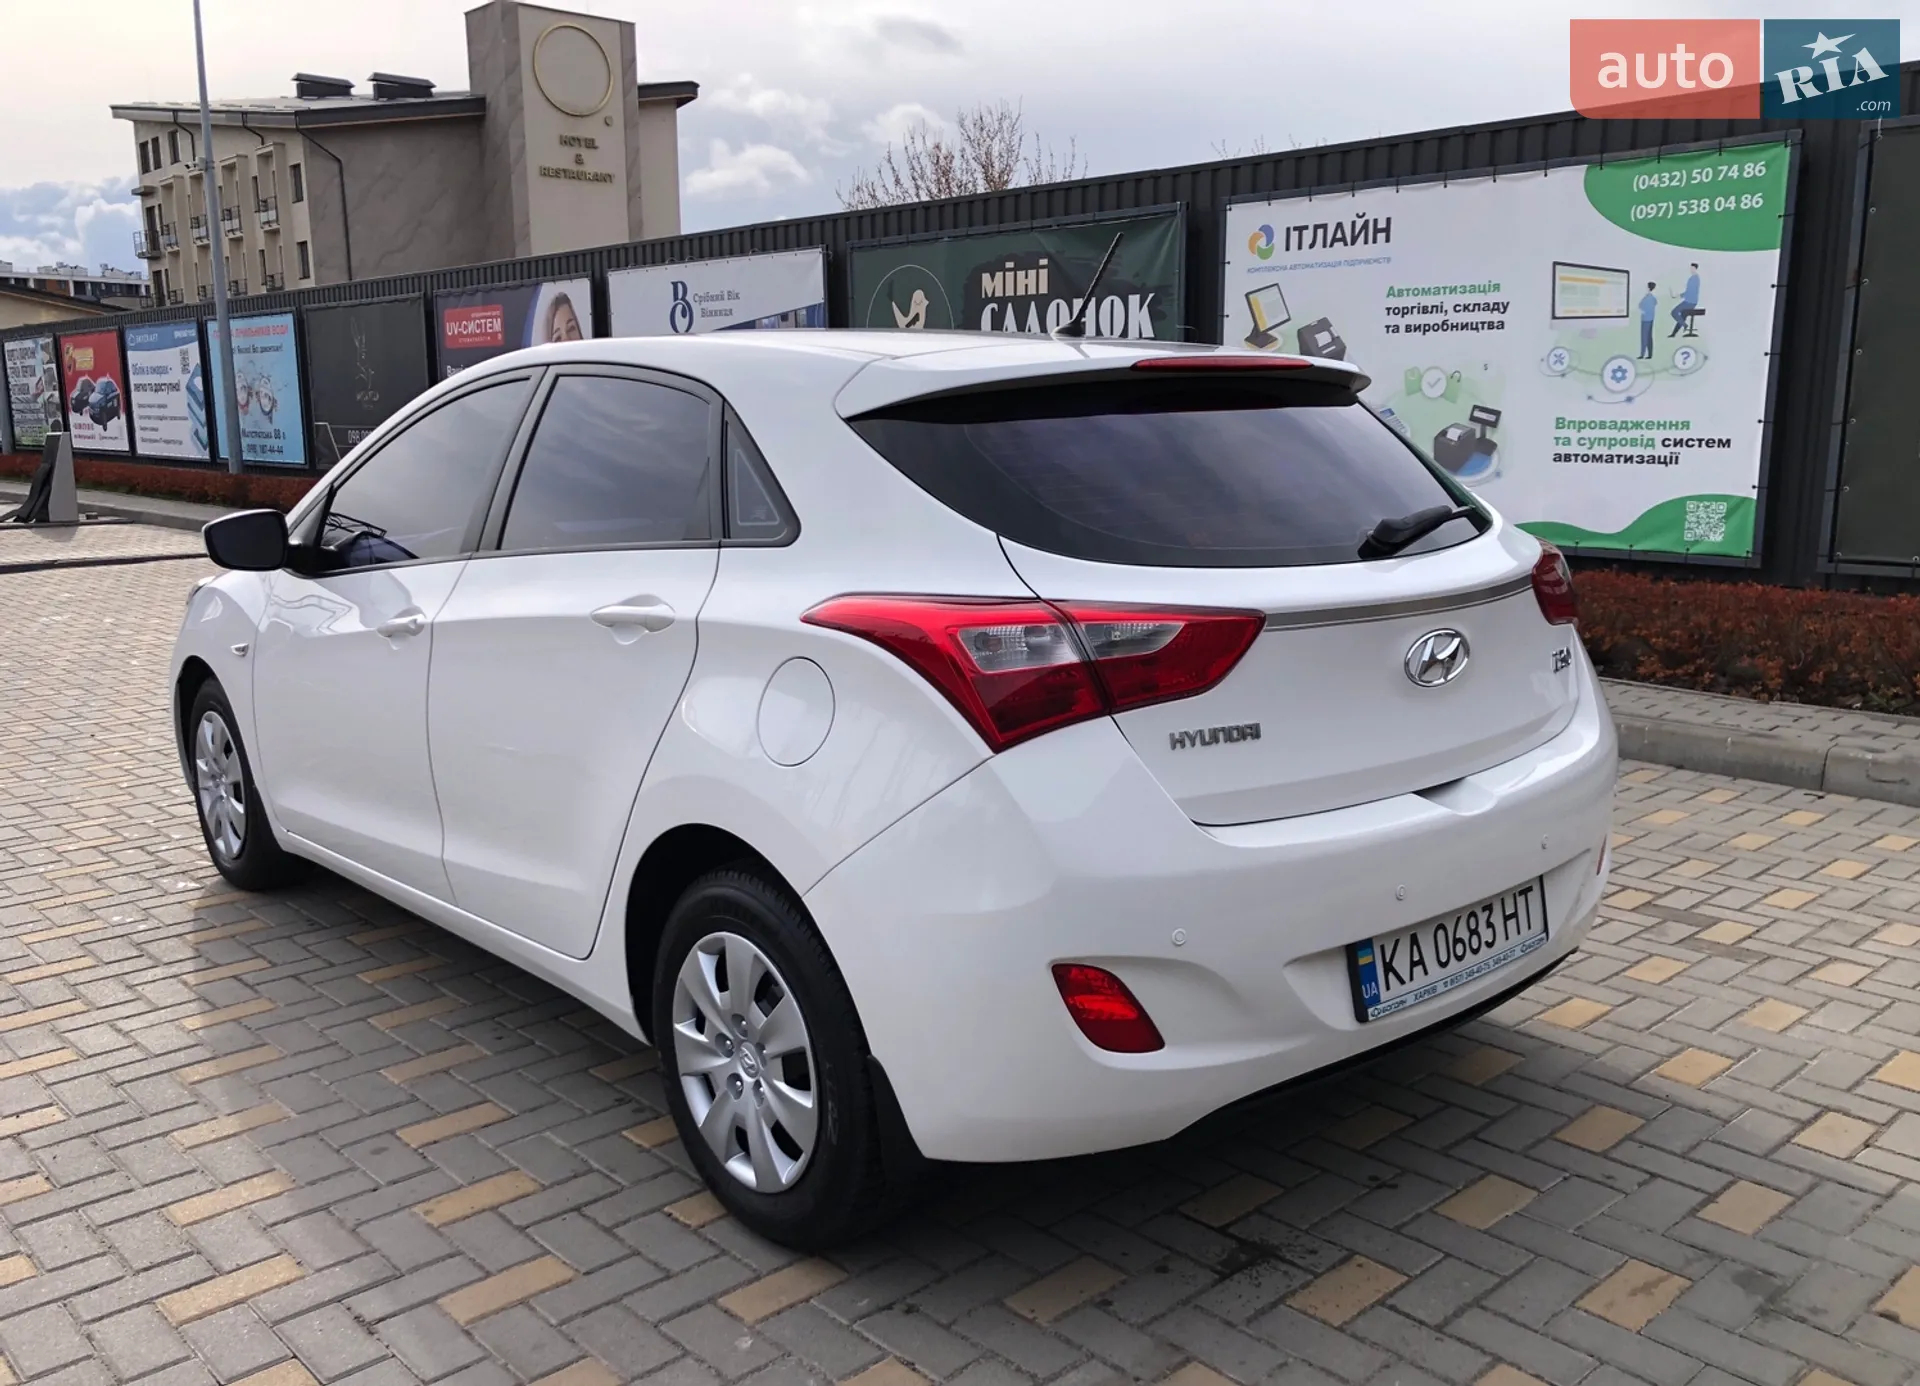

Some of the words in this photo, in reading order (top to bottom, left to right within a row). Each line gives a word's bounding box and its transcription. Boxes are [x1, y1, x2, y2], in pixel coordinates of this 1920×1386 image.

[559, 134, 598, 149] HOTEL
[574, 153, 584, 165] &
[539, 165, 615, 183] RESTAURANT
[1633, 171, 1687, 192] (0432)
[1691, 168, 1713, 184] 50
[1717, 165, 1740, 181] 74
[1743, 161, 1766, 178] 86
[1630, 201, 1673, 221] (097)
[1677, 198, 1710, 215] 538
[1714, 195, 1737, 212] 04
[1740, 192, 1764, 209] 86
[1285, 212, 1392, 251] ІТЛАЙН
[693, 290, 725, 305] Срібний
[727, 289, 741, 301] Вік
[1386, 280, 1501, 298] Автоматизація
[1385, 302, 1448, 318] торгівлі,
[1453, 301, 1510, 314] складу
[446, 318, 502, 336] UV-СИСТЕМ
[1384, 324, 1400, 334] та
[1404, 319, 1505, 335] виробництва
[1555, 417, 1691, 433] Впровадження
[1553, 436, 1572, 447] та
[1577, 434, 1656, 450] супровід
[1661, 437, 1732, 448] систем
[1552, 452, 1681, 467] автоматизації
[1169, 722, 1262, 750] HYUNDAI
[1380, 932, 1429, 991] KA
[1433, 902, 1497, 969] 0683
[1500, 885, 1533, 941] HT
[1362, 982, 1378, 999] UA
